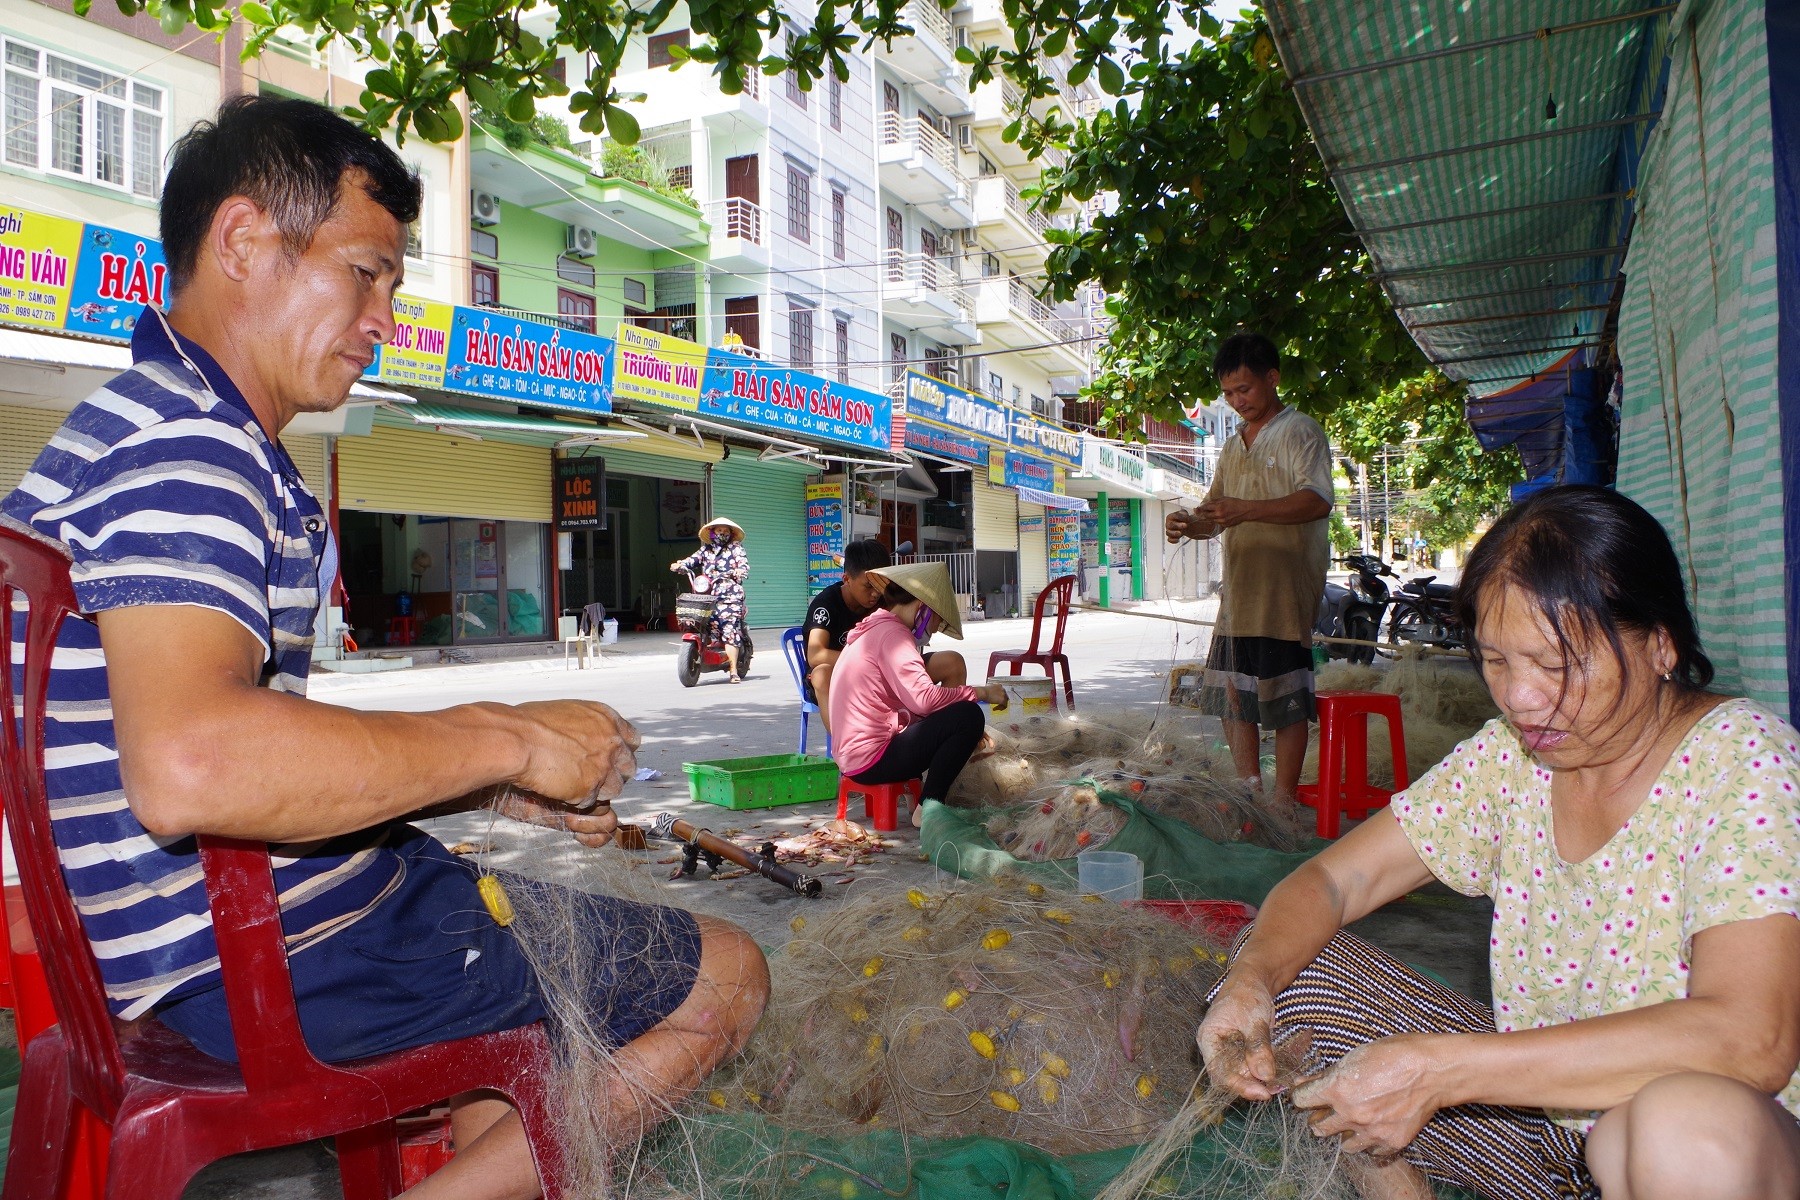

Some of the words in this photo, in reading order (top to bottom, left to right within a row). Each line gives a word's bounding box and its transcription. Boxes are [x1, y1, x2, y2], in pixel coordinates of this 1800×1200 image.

[0, 212, 23, 234] ghỉ
[0, 247, 25, 280] NG
[32, 248, 67, 287] VÂN
[98, 242, 166, 306] HẢI
[43, 294, 56, 305] SƠN
[392, 297, 407, 314] Nhà
[15, 305, 30, 317] 0989
[32, 309, 43, 319] 427
[45, 310, 55, 321] 276
[416, 326, 445, 355] XINH
[625, 329, 642, 343] Nhà
[643, 336, 661, 350] nghỉ
[466, 318, 499, 367] HẢI
[502, 325, 536, 374] SẢN
[538, 328, 571, 380] SẦM
[574, 349, 604, 386] SƠN
[623, 351, 671, 384] TRƯỜNG
[675, 363, 698, 389] VÂN
[482, 373, 495, 388] GHẸ
[499, 376, 511, 391] CUA
[515, 377, 528, 393] TÔM
[531, 379, 540, 395] CÁ
[732, 362, 767, 403] HẢI
[771, 373, 806, 410] SẢN
[809, 381, 842, 420] SẦM
[845, 401, 875, 428] SƠN
[745, 405, 759, 419] GHẸ
[765, 409, 779, 422] CUA
[783, 411, 798, 426] TÔM
[802, 415, 812, 429] CÁ
[853, 427, 862, 440] ỐC
[1039, 425, 1080, 457] CHUNG
[1024, 463, 1047, 480] CHUNG
[565, 476, 591, 498] LỘC
[563, 500, 597, 517] XINH
